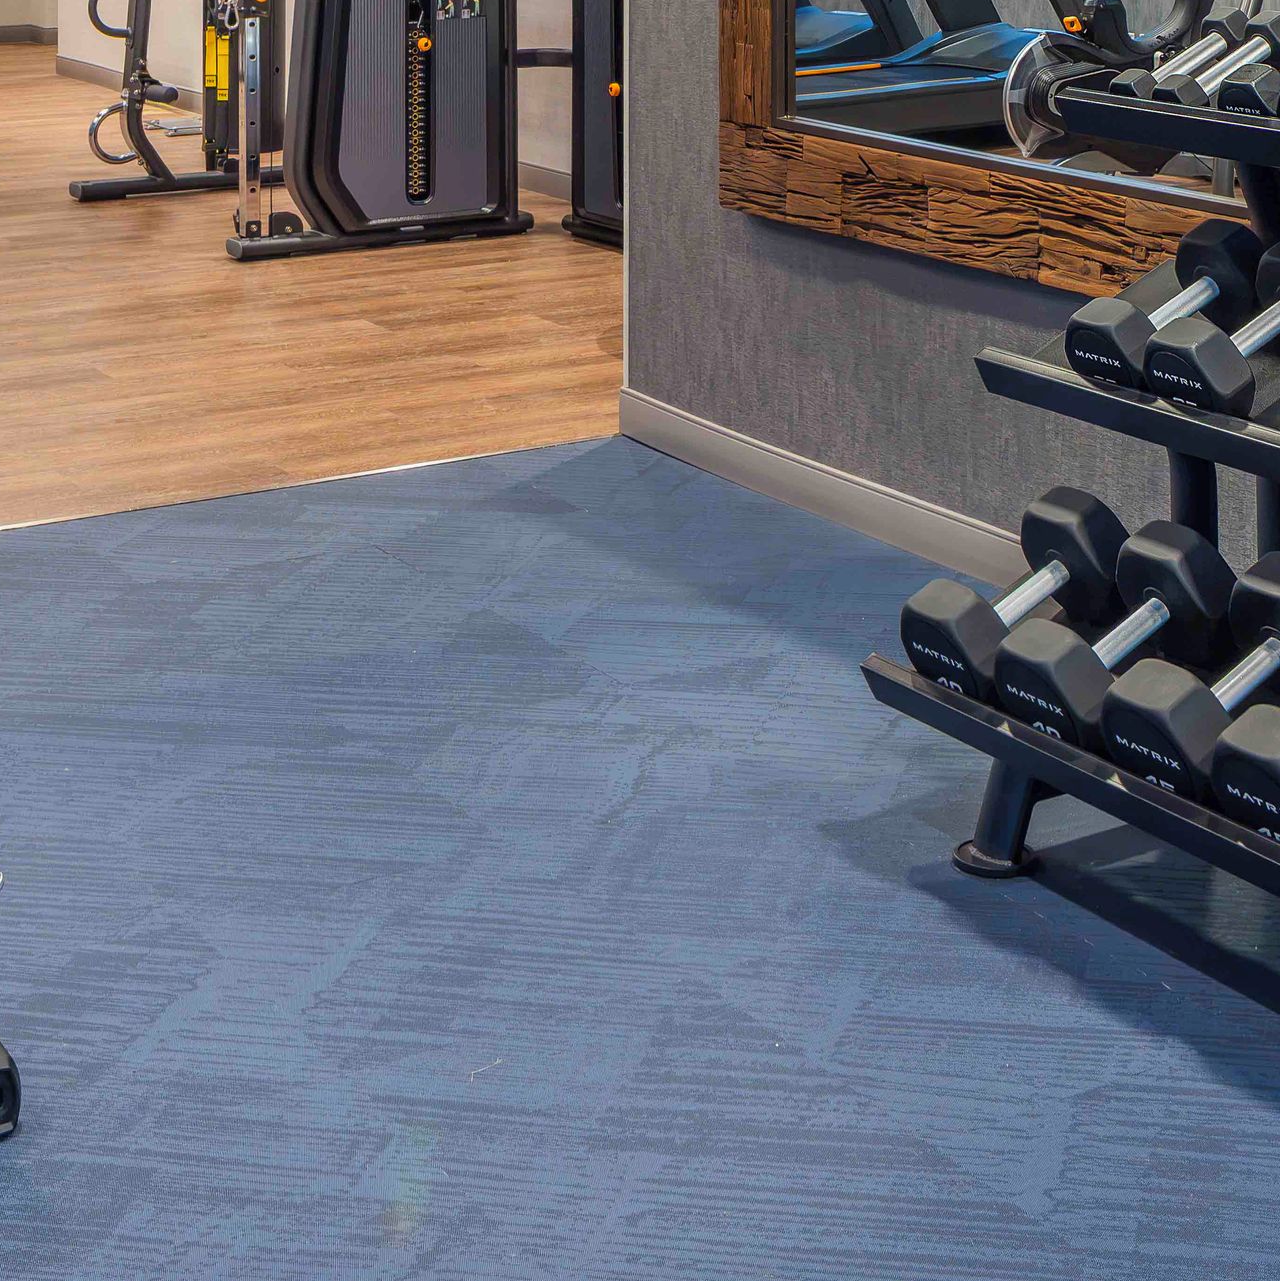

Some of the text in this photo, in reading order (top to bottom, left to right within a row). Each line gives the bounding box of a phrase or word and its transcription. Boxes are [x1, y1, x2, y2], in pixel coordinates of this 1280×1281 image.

[1226, 105, 1260, 115] MATRIX
[1074, 350, 1120, 368] MATRIX
[1154, 370, 1202, 390] MATRIX
[912, 641, 964, 670] MATRIX
[1006, 684, 1064, 717] MATRIX
[1116, 734, 1181, 770] MATRIX
